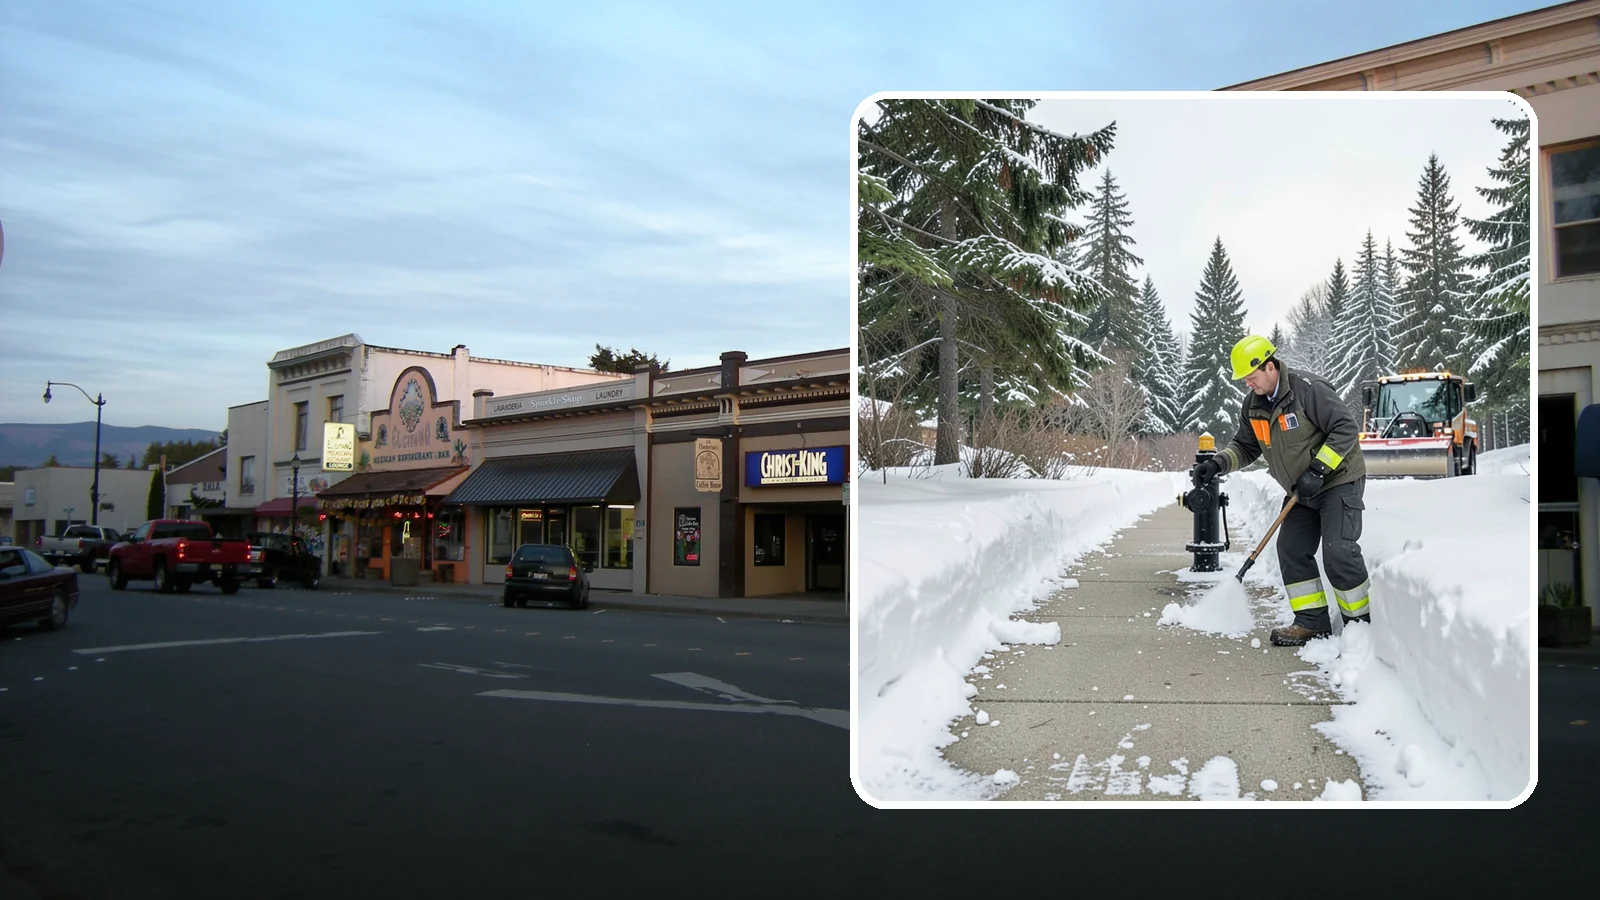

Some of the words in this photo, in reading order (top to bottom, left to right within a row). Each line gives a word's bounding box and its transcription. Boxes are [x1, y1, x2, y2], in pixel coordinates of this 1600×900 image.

[493, 402, 522, 413] LAVANDERIA
[530, 399, 560, 409] Sparkle
[561, 394, 583, 404] Shop
[595, 389, 624, 400] LAUNDRY
[391, 425, 402, 449] EL
[327, 449, 352, 457] MEXICAN
[373, 454, 396, 464] MEXICAN
[397, 451, 433, 462] RESTAURANT
[438, 450, 450, 459] BAR
[761, 452, 797, 478] CHRIST
[799, 450, 827, 476] KING
